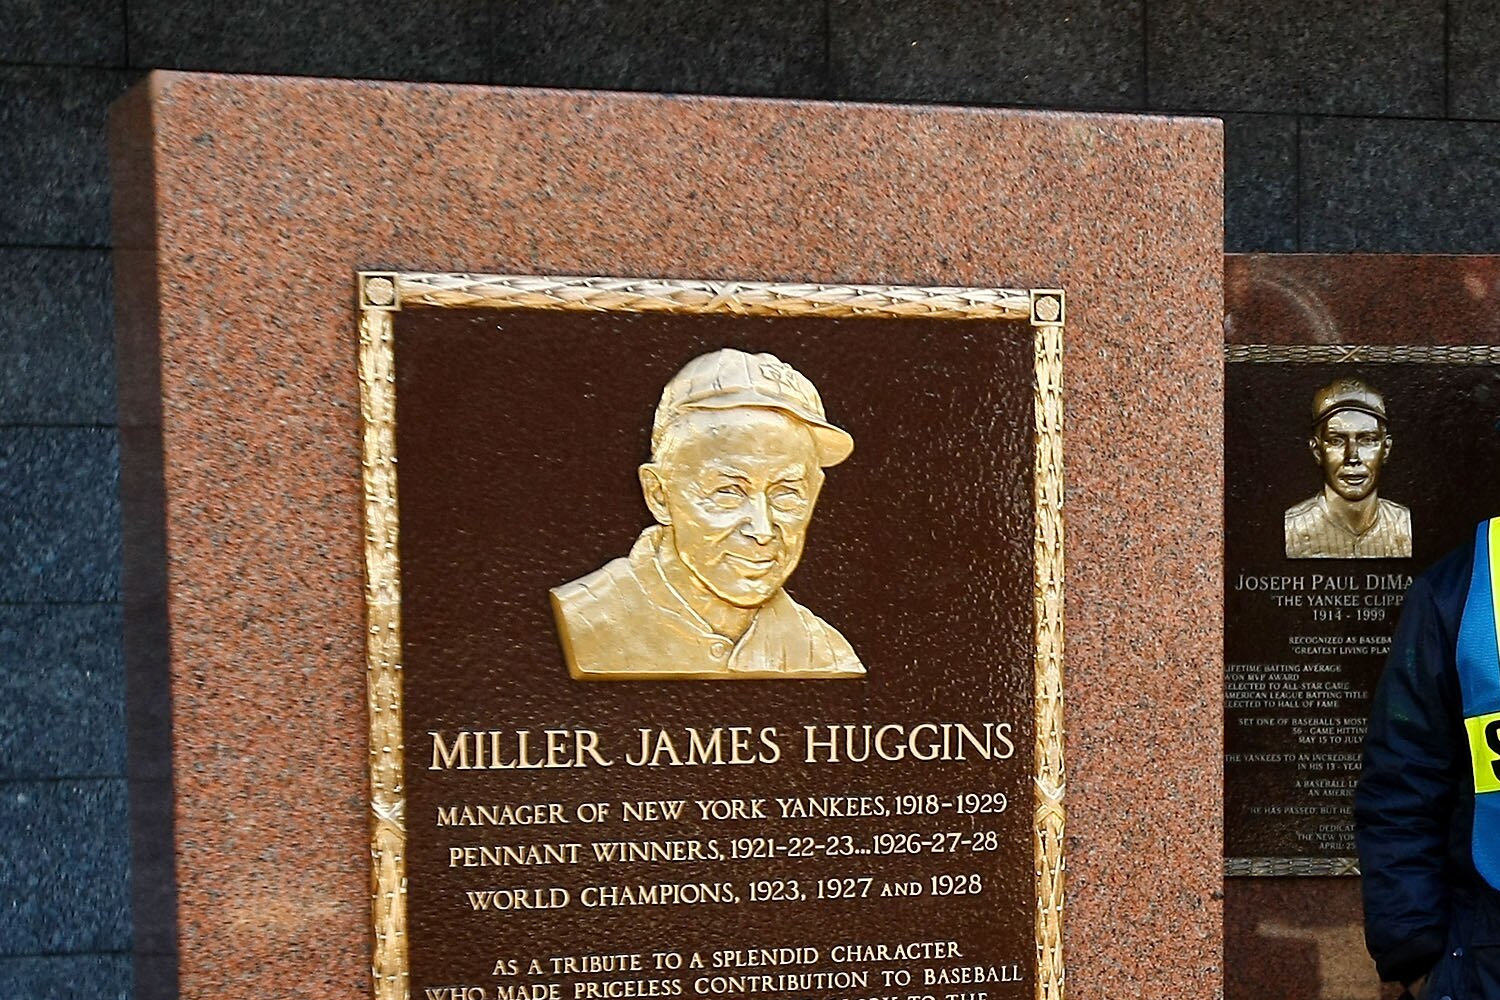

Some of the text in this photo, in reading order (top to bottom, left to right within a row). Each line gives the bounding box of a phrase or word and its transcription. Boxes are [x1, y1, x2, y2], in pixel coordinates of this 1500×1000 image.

[1236, 574, 1304, 591] JOSEPH
[1312, 574, 1359, 590] PAUL
[1307, 596, 1360, 606] YANKEE
[1314, 609, 1385, 621] 1914 1999
[429, 722, 1015, 770] MILLER JAMES HUGGINS
[437, 804, 569, 826] MANAGER
[577, 803, 609, 823] OF
[623, 800, 683, 822] NEW
[698, 799, 766, 820] YORK
[776, 797, 891, 818] YANKEES,
[450, 844, 580, 867] PENNANT
[594, 841, 725, 863] WINNERS,
[467, 875, 982, 911] WORLD CHAMPIONS, 1923, 1927 AND 1928
[493, 942, 963, 976] AS A TRIBUTE TO A SPLENDID CHARACTER
[574, 978, 682, 999] PRICELESS
[694, 971, 869, 994] CONTRIBUTION
[882, 970, 911, 987] TO
[924, 966, 1023, 985] BASEBALL
